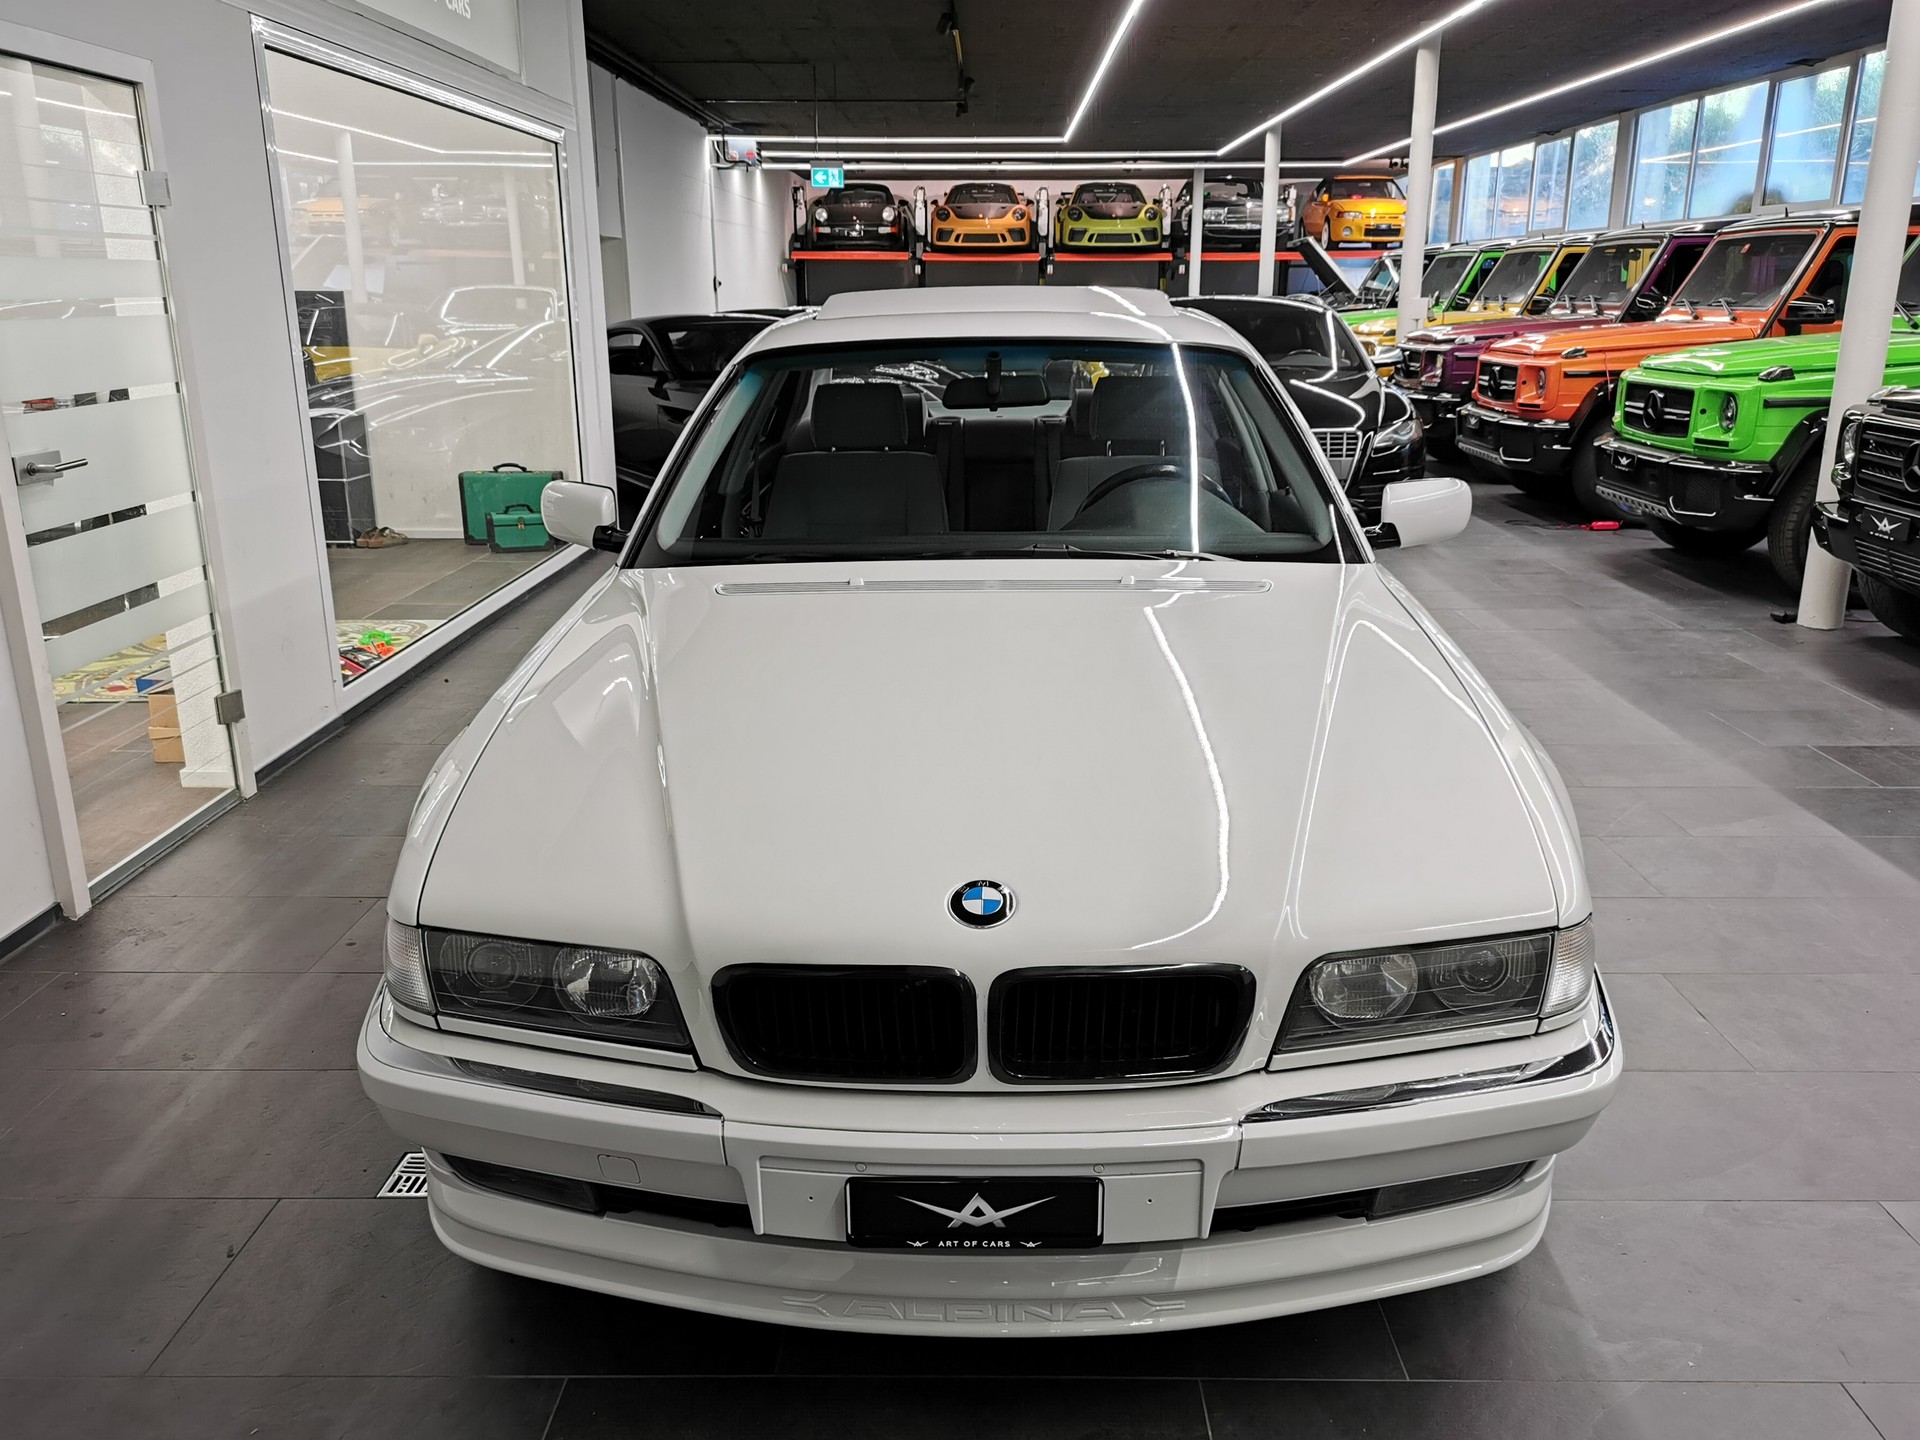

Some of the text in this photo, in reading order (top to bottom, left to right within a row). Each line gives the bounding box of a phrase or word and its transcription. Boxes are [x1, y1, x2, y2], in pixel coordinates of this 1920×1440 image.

[938, 1240, 1011, 1248] ART OF CARS
[843, 1299, 1126, 1323] ALPINA
